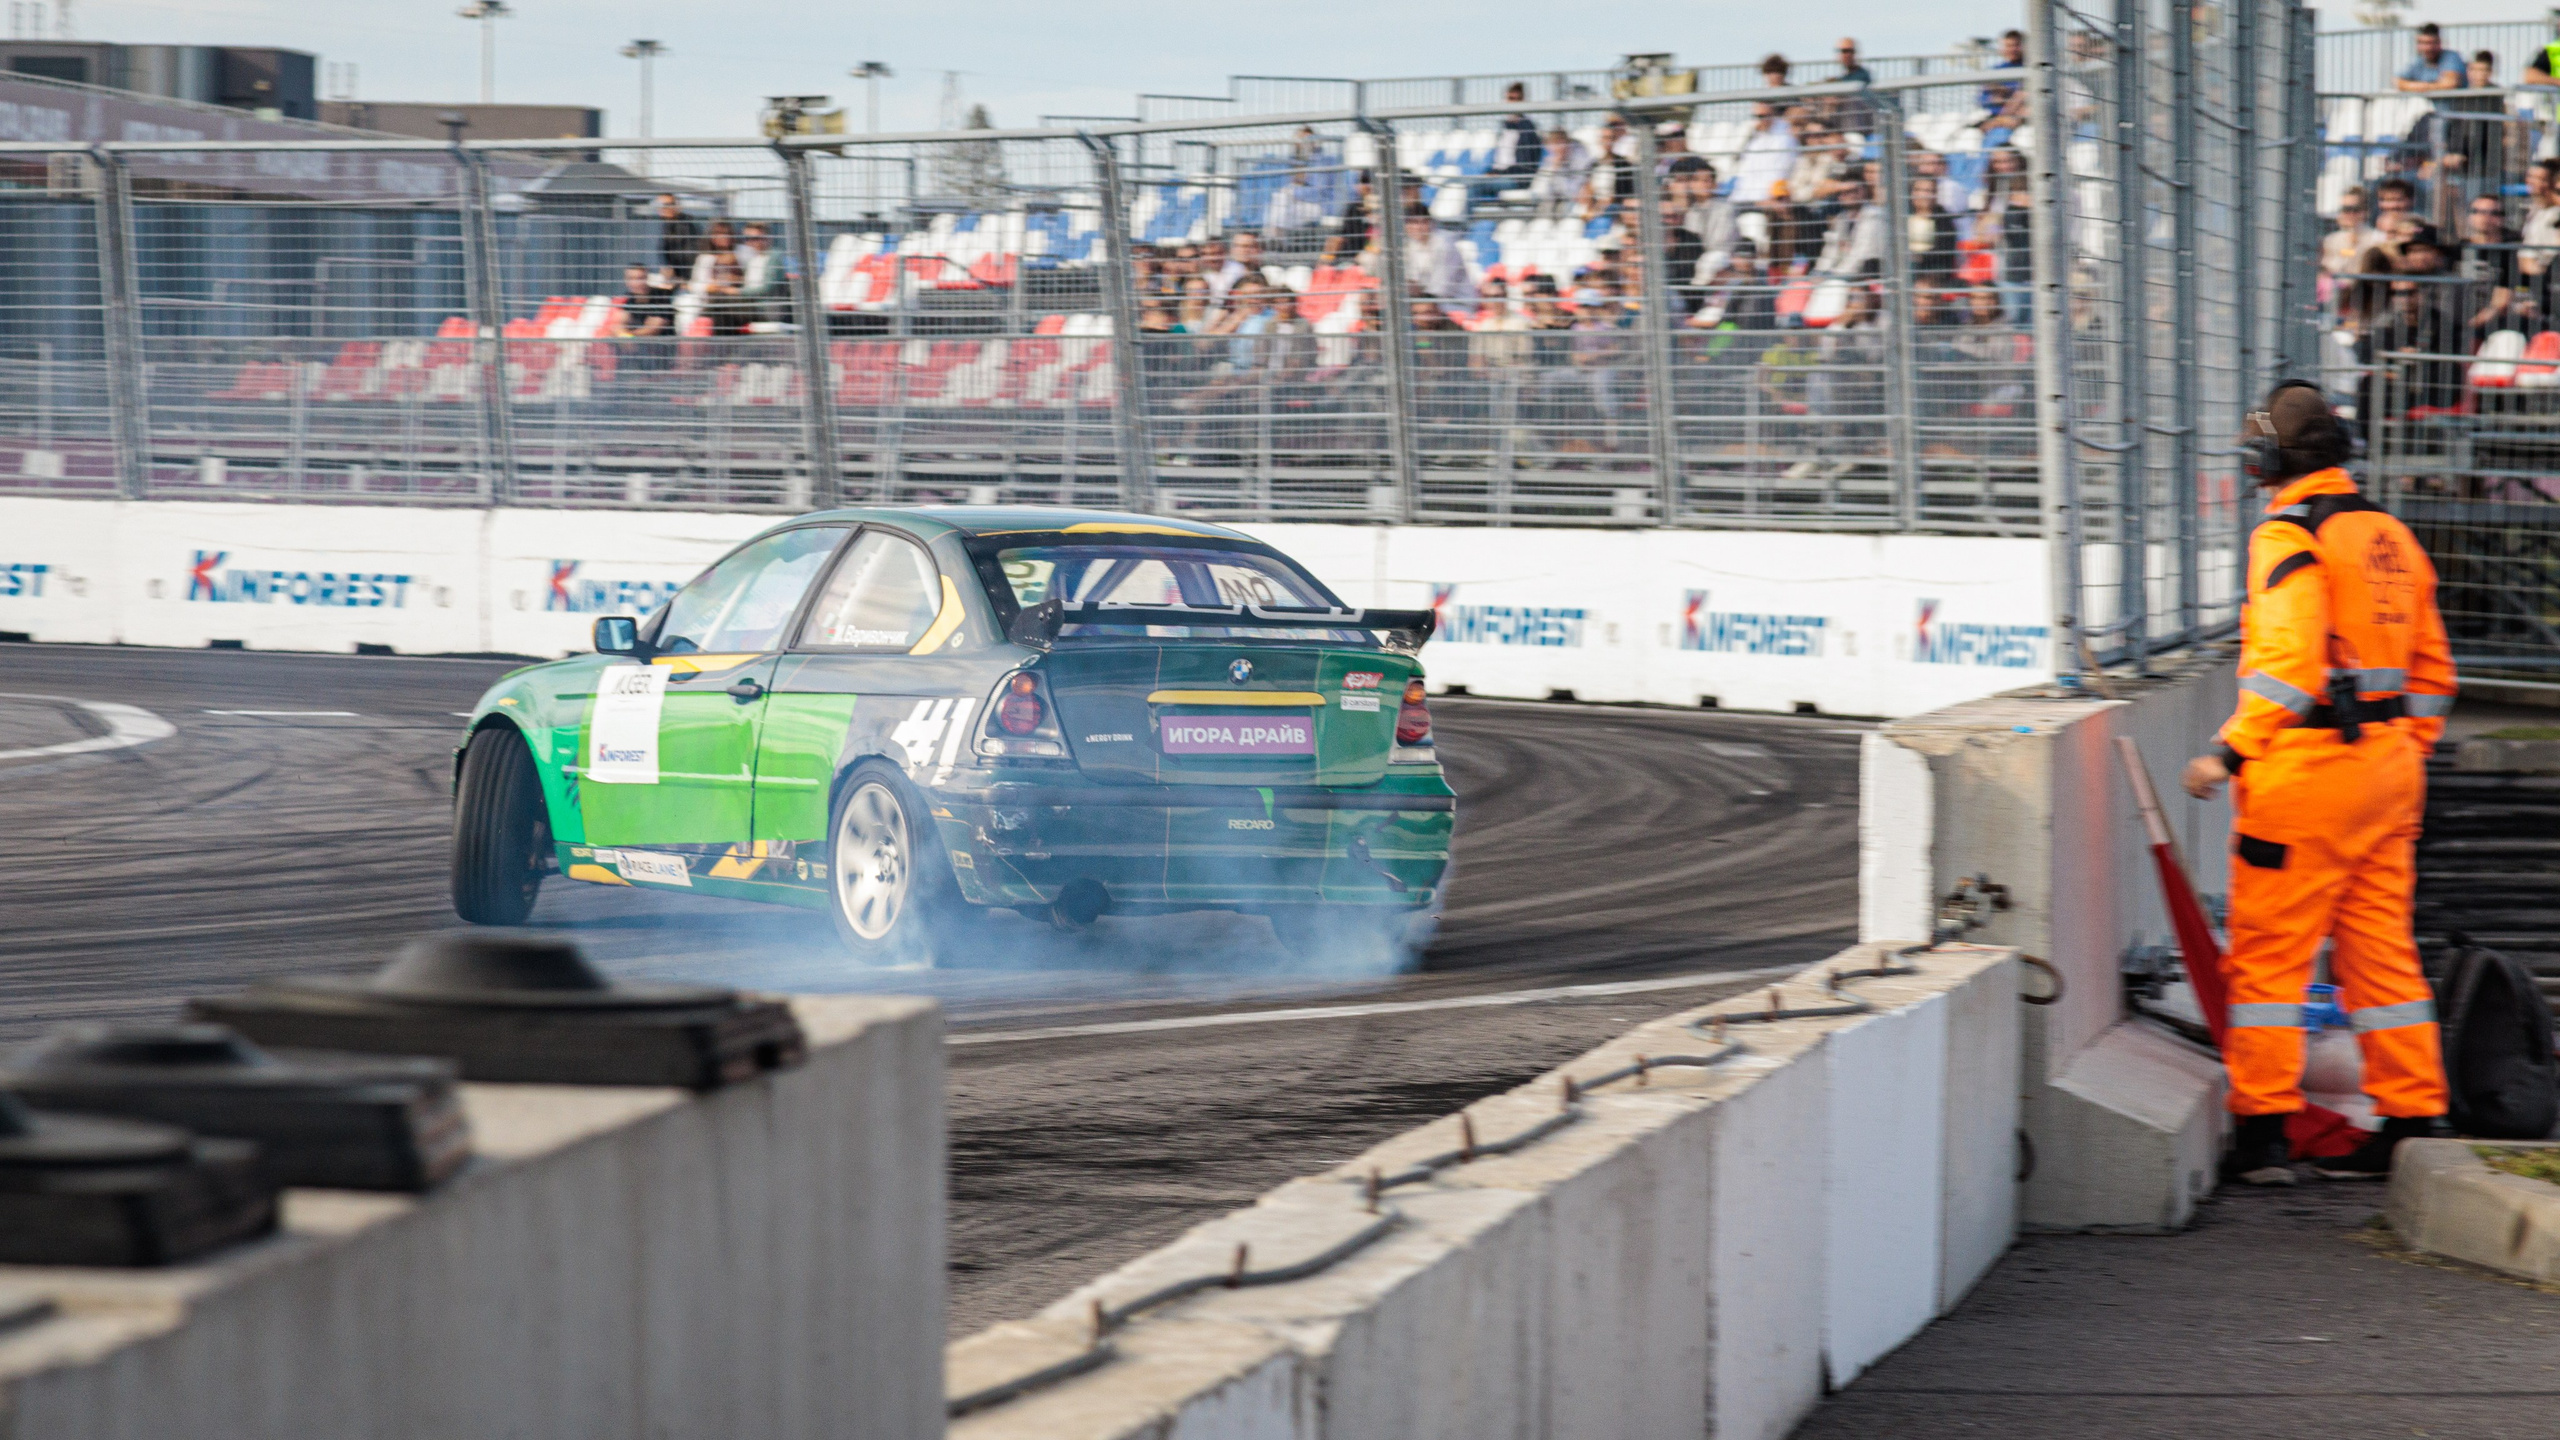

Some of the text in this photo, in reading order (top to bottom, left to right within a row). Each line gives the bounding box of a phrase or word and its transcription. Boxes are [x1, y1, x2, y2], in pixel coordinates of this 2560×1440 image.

[187, 550, 412, 608] KINFOREST
[890, 698, 976, 786] 41
[1168, 724, 1306, 745] ИГОРА ДРАЙВ
[1228, 819, 1275, 830] RECARO
